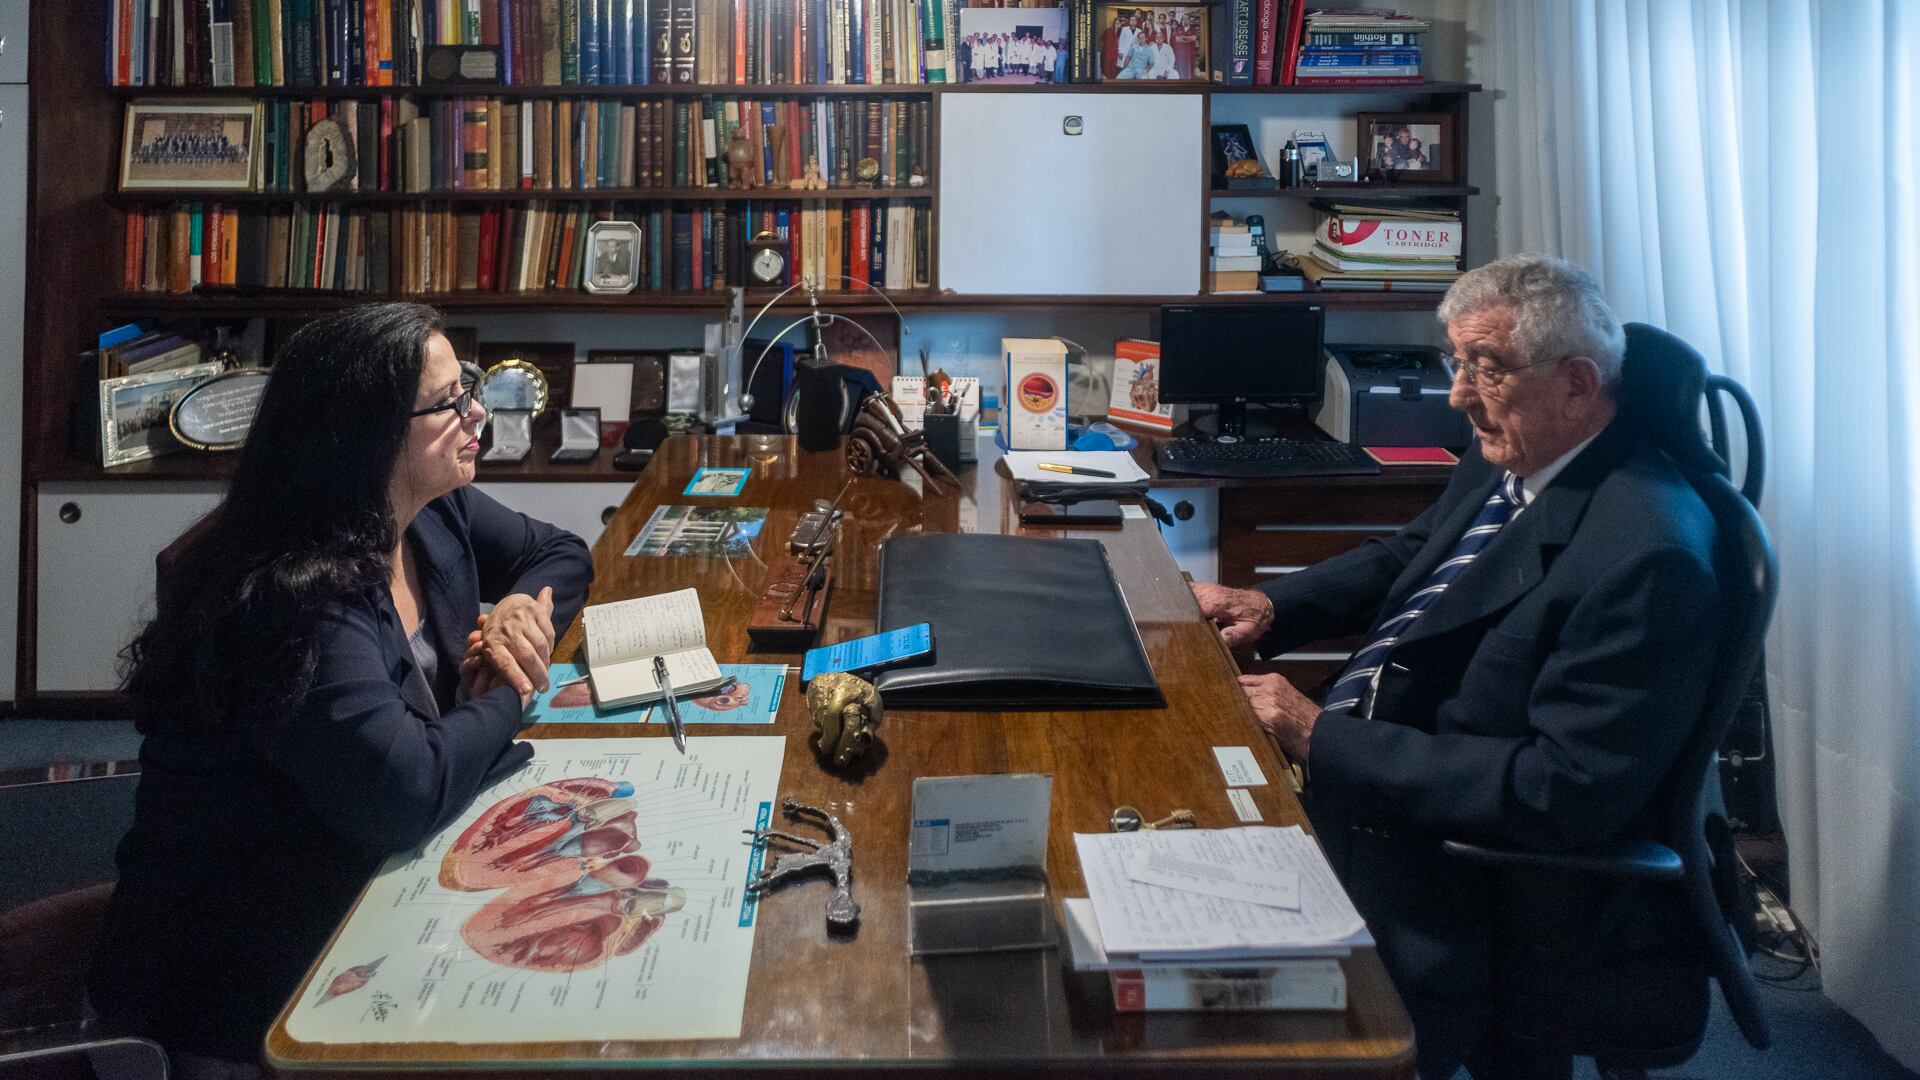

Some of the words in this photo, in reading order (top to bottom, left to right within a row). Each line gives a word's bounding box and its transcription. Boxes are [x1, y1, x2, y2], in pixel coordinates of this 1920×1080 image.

[1239, 0, 1248, 17] ART
[1262, 0, 1271, 28] diología
[1239, 20, 1248, 56] DISEASE
[1383, 228, 1450, 243] TONER
